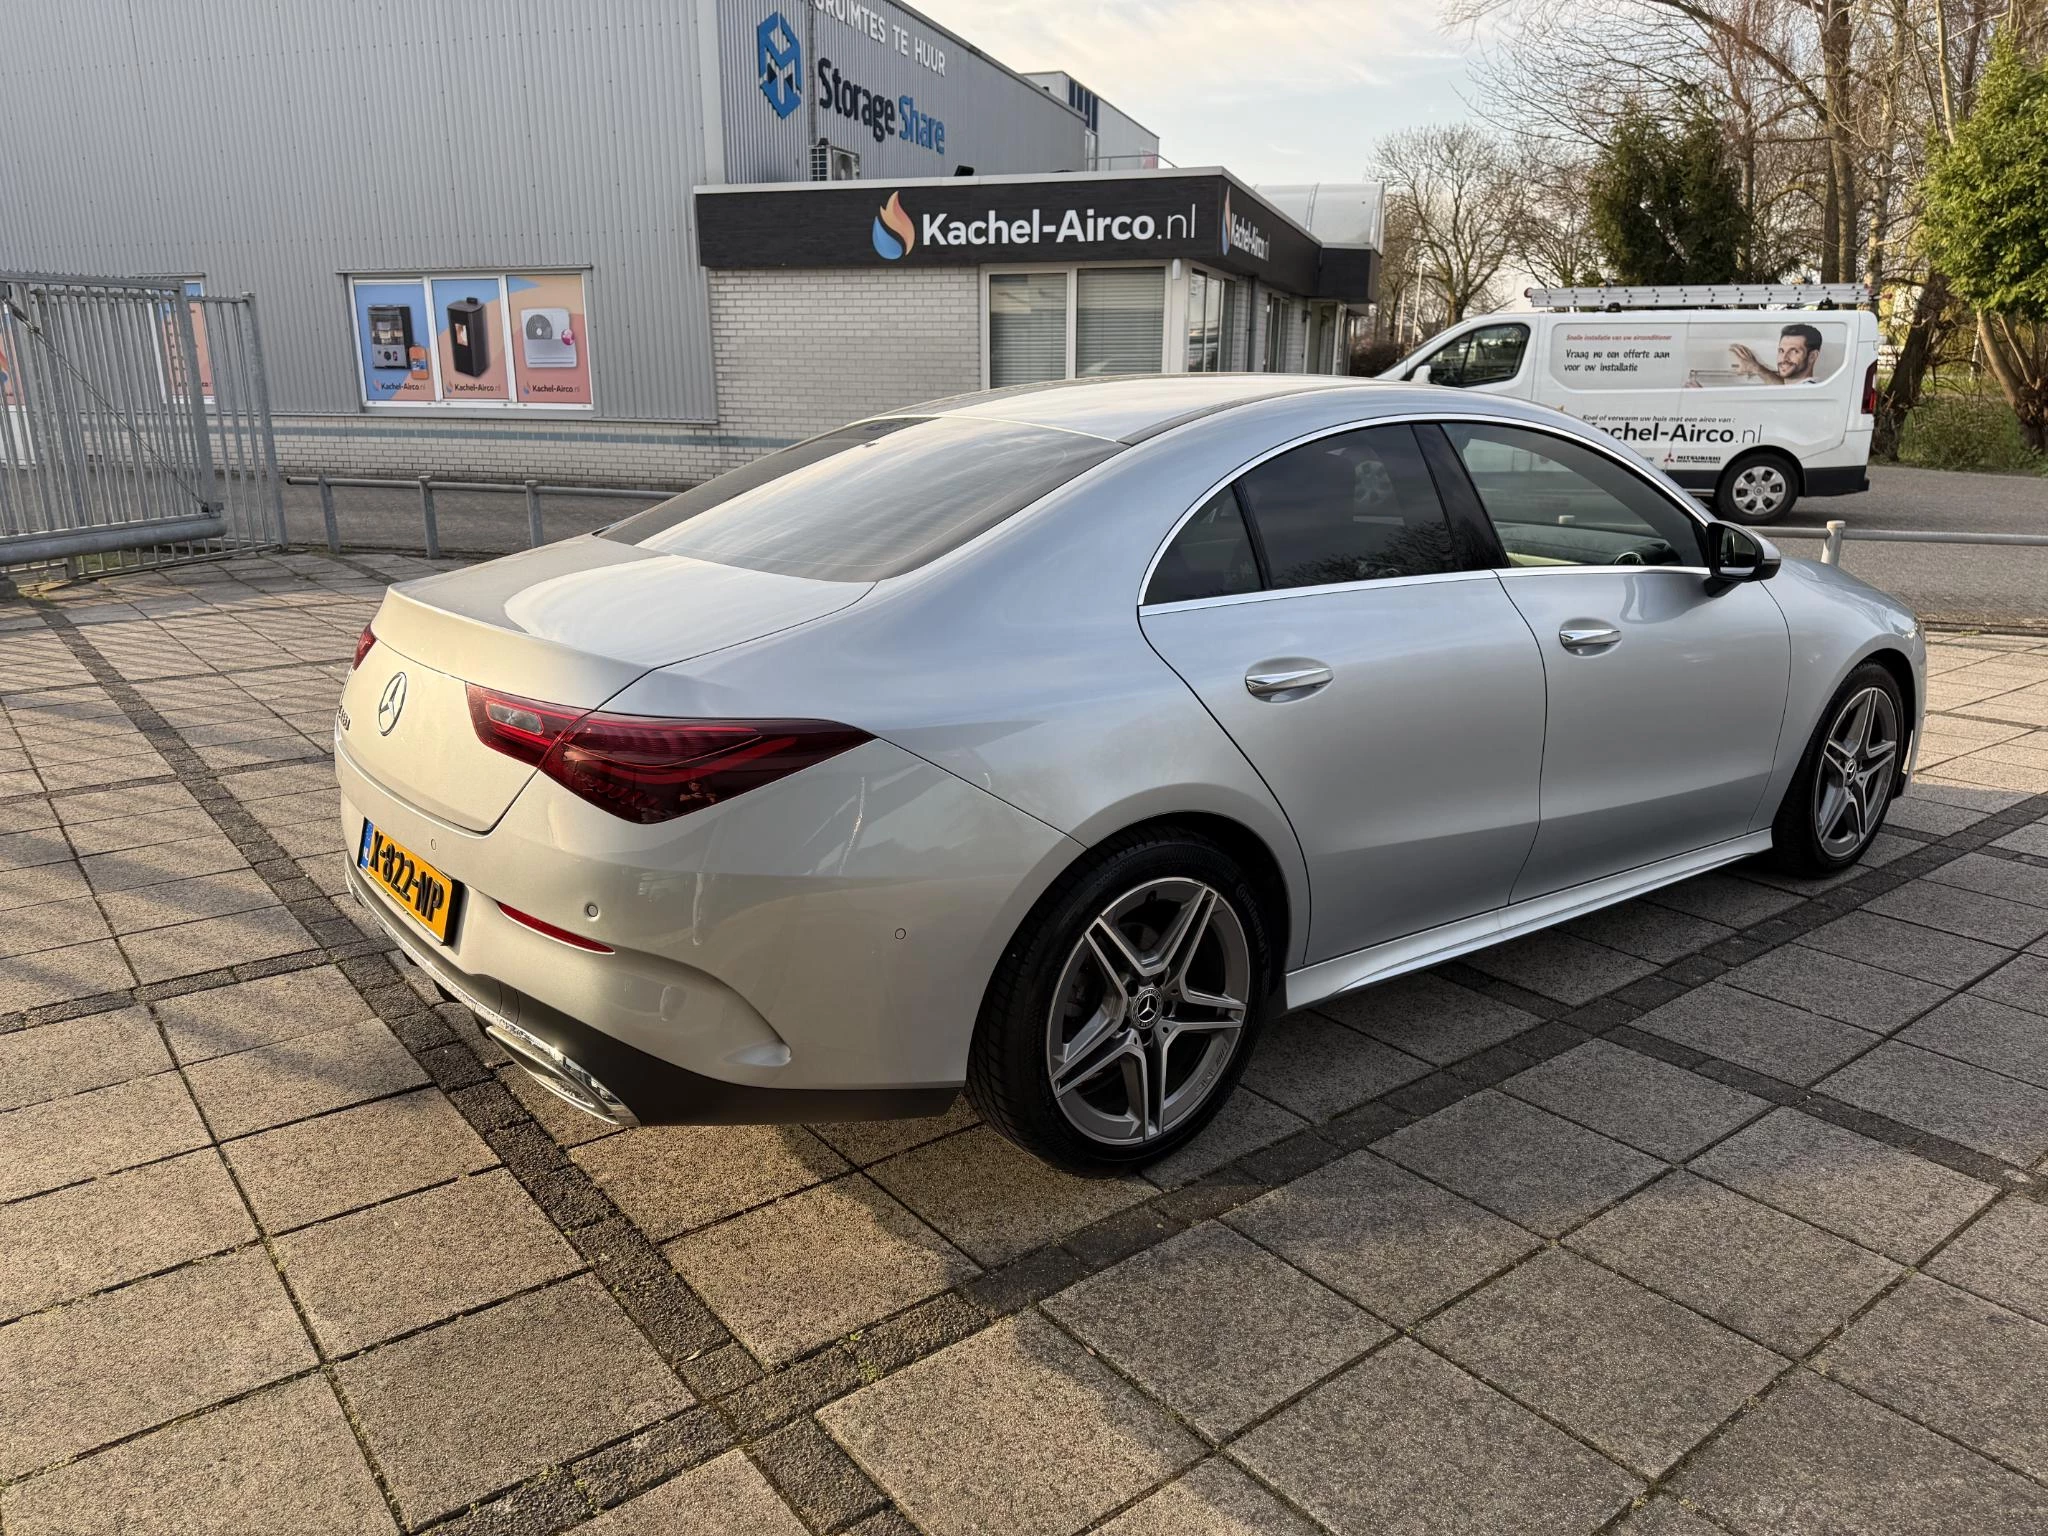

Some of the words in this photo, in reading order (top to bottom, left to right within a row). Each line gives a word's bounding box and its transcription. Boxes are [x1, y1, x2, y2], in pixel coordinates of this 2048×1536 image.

[892, 25, 909, 56] TE
[914, 37, 946, 77] HUUR
[818, 57, 895, 142] Storage
[899, 95, 945, 155] Share
[922, 203, 1196, 246] Kachel-Airco.nl
[1231, 212, 1270, 262] Kachel-Airco.nl
[1564, 363, 1581, 372] voor
[1584, 364, 1597, 372] uw
[1600, 362, 1639, 372] installatie
[1566, 348, 1590, 360] Vraag
[1593, 351, 1603, 359] nu
[1607, 351, 1620, 359] een
[1623, 348, 1650, 359] offerte
[1653, 351, 1671, 359] aan
[1592, 422, 1762, 444] chel-Airco.nl
[369, 830, 445, 923] X-822-NP
